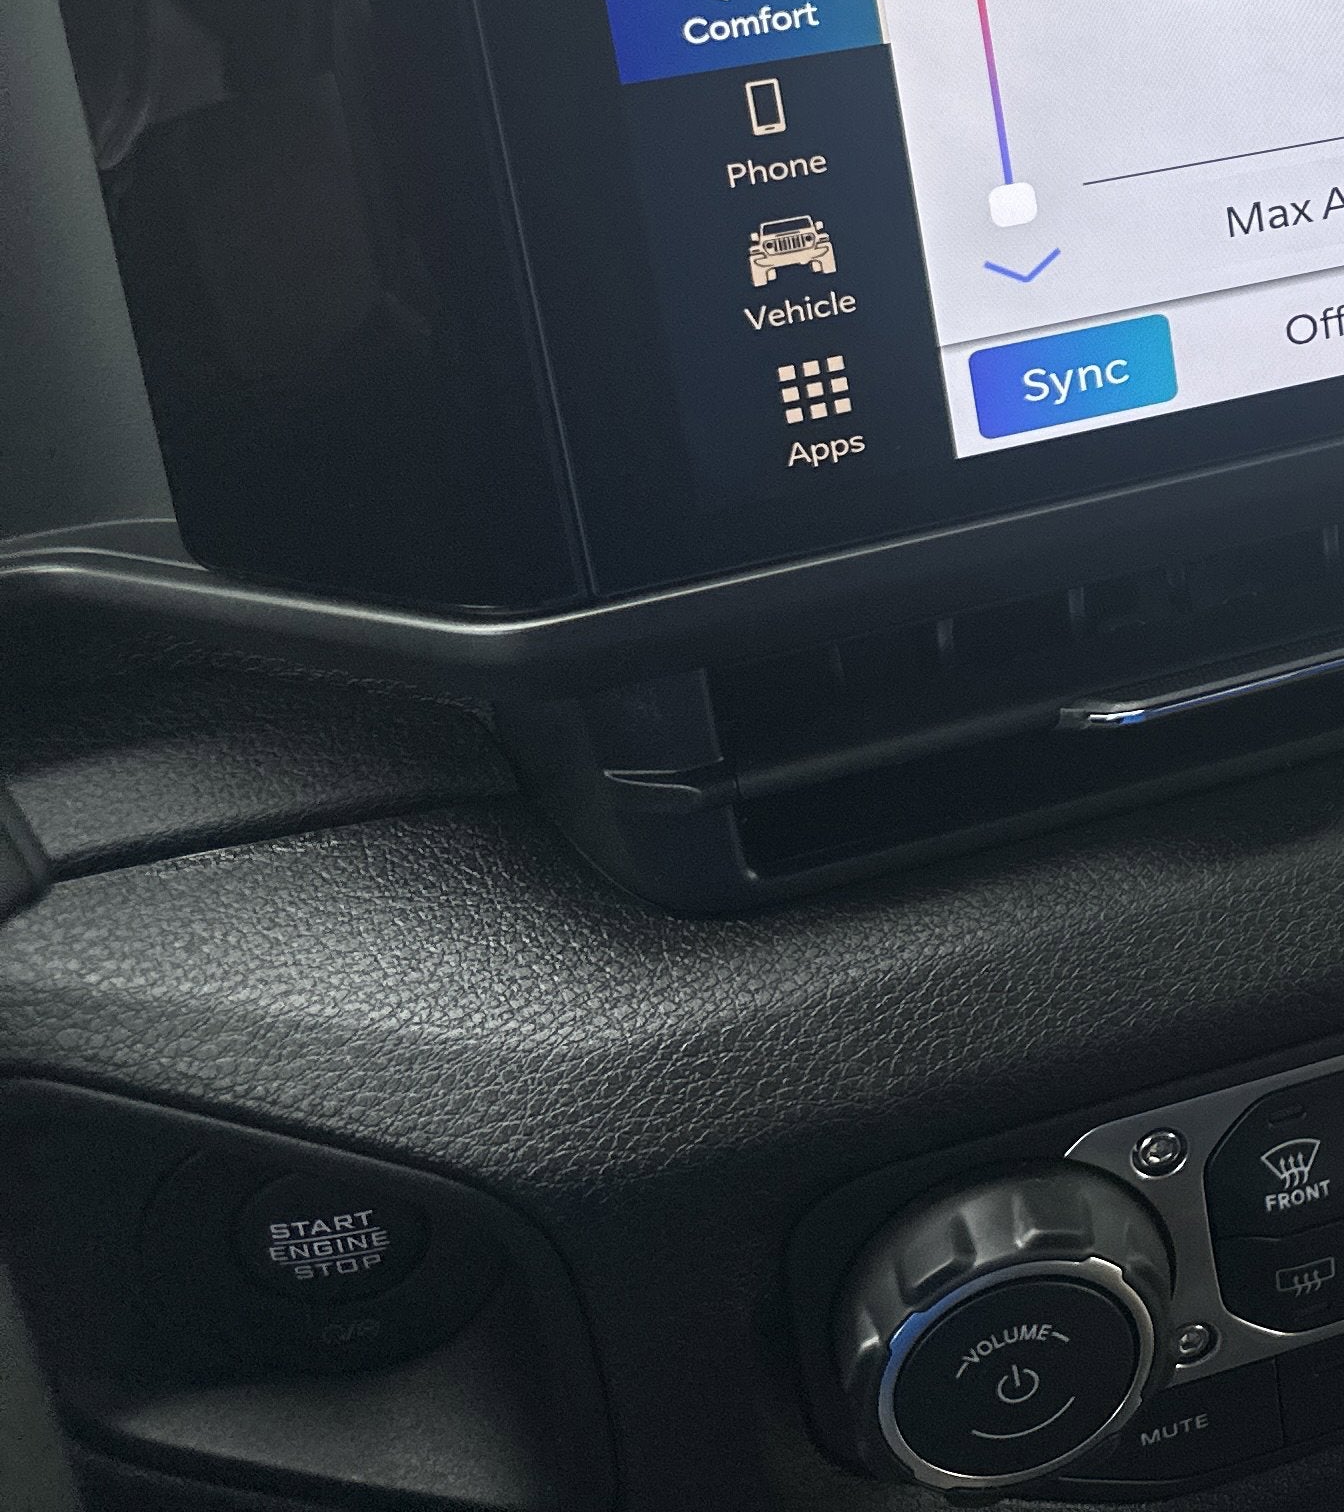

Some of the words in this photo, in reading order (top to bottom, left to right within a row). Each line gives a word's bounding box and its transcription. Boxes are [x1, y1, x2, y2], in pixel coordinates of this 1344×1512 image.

[683, 1, 820, 45] Comfort
[727, 152, 828, 188] Phone
[1226, 198, 1312, 238] Max
[744, 291, 857, 331] Vehicle
[1023, 355, 1130, 406] Sync
[788, 432, 866, 467] Apps
[1265, 1179, 1331, 1212] FRONT
[270, 1209, 373, 1239] START
[269, 1230, 391, 1261] ENGINE
[294, 1253, 382, 1280] STOP
[963, 1324, 1053, 1368] VOLUME
[1140, 1413, 1210, 1446] MUTE
